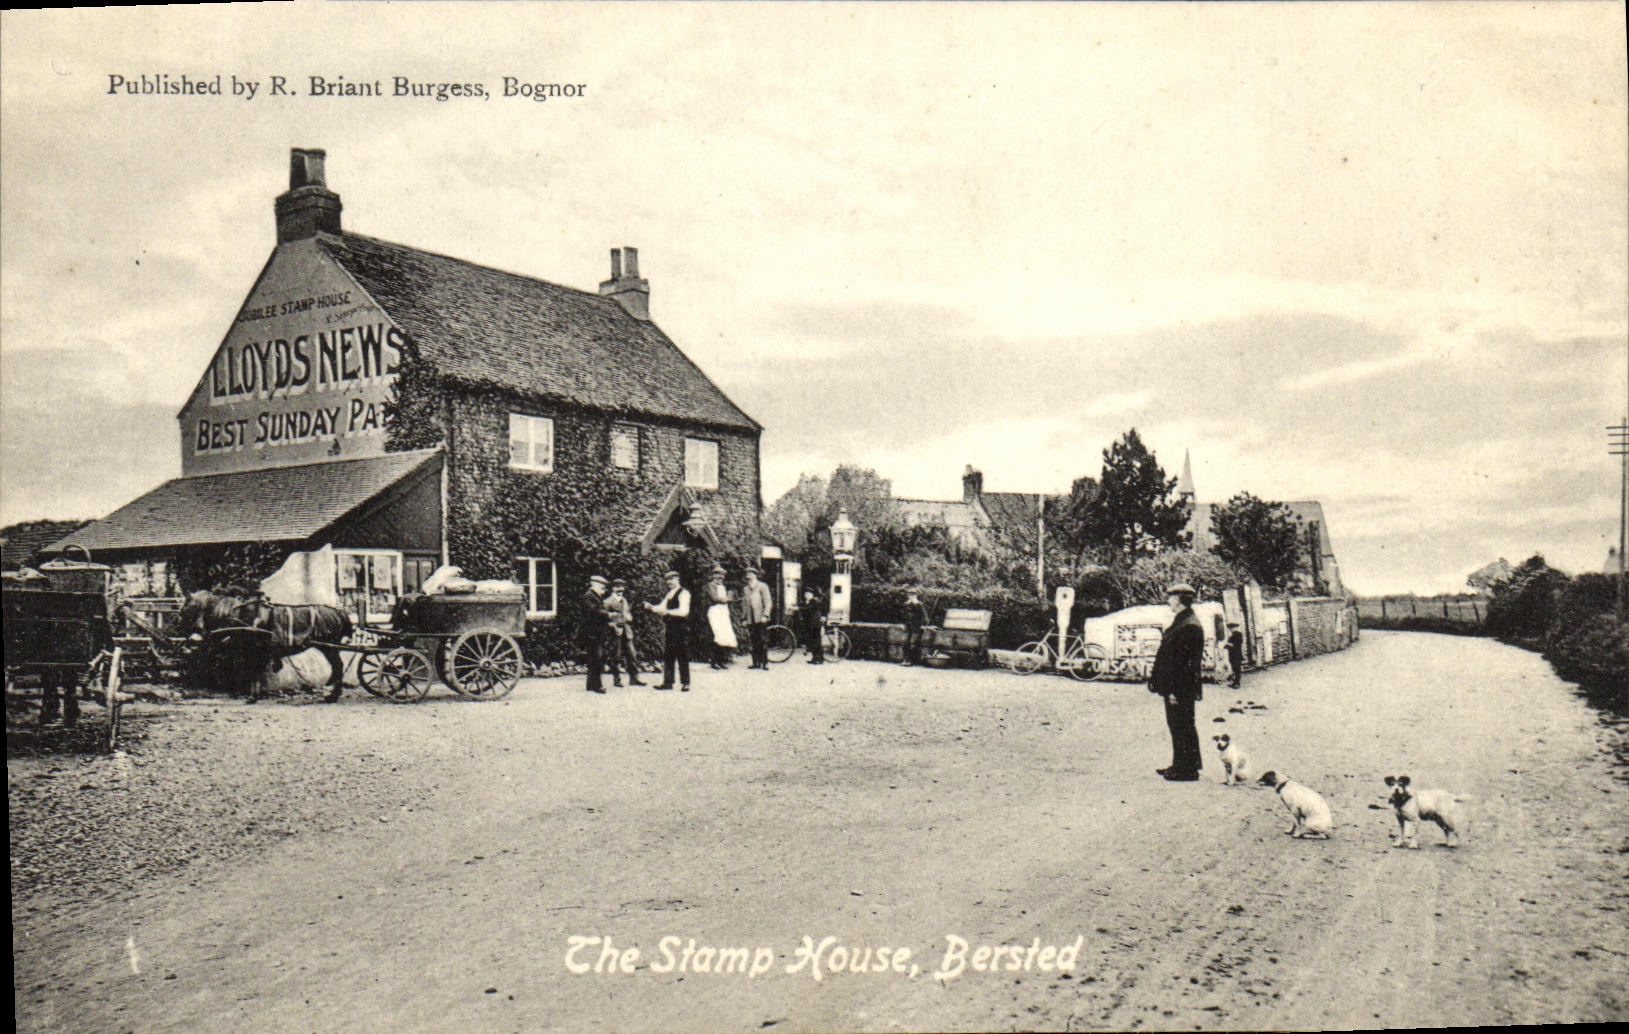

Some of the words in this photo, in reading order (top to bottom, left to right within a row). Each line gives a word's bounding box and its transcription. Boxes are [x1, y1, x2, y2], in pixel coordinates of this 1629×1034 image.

[280, 298, 316, 315] STAMP
[317, 291, 352, 309] HOUSE
[211, 335, 311, 396] LLOYDS
[317, 323, 404, 384] NEWS
[197, 419, 248, 450] BEST
[255, 406, 341, 443] SUNDAY
